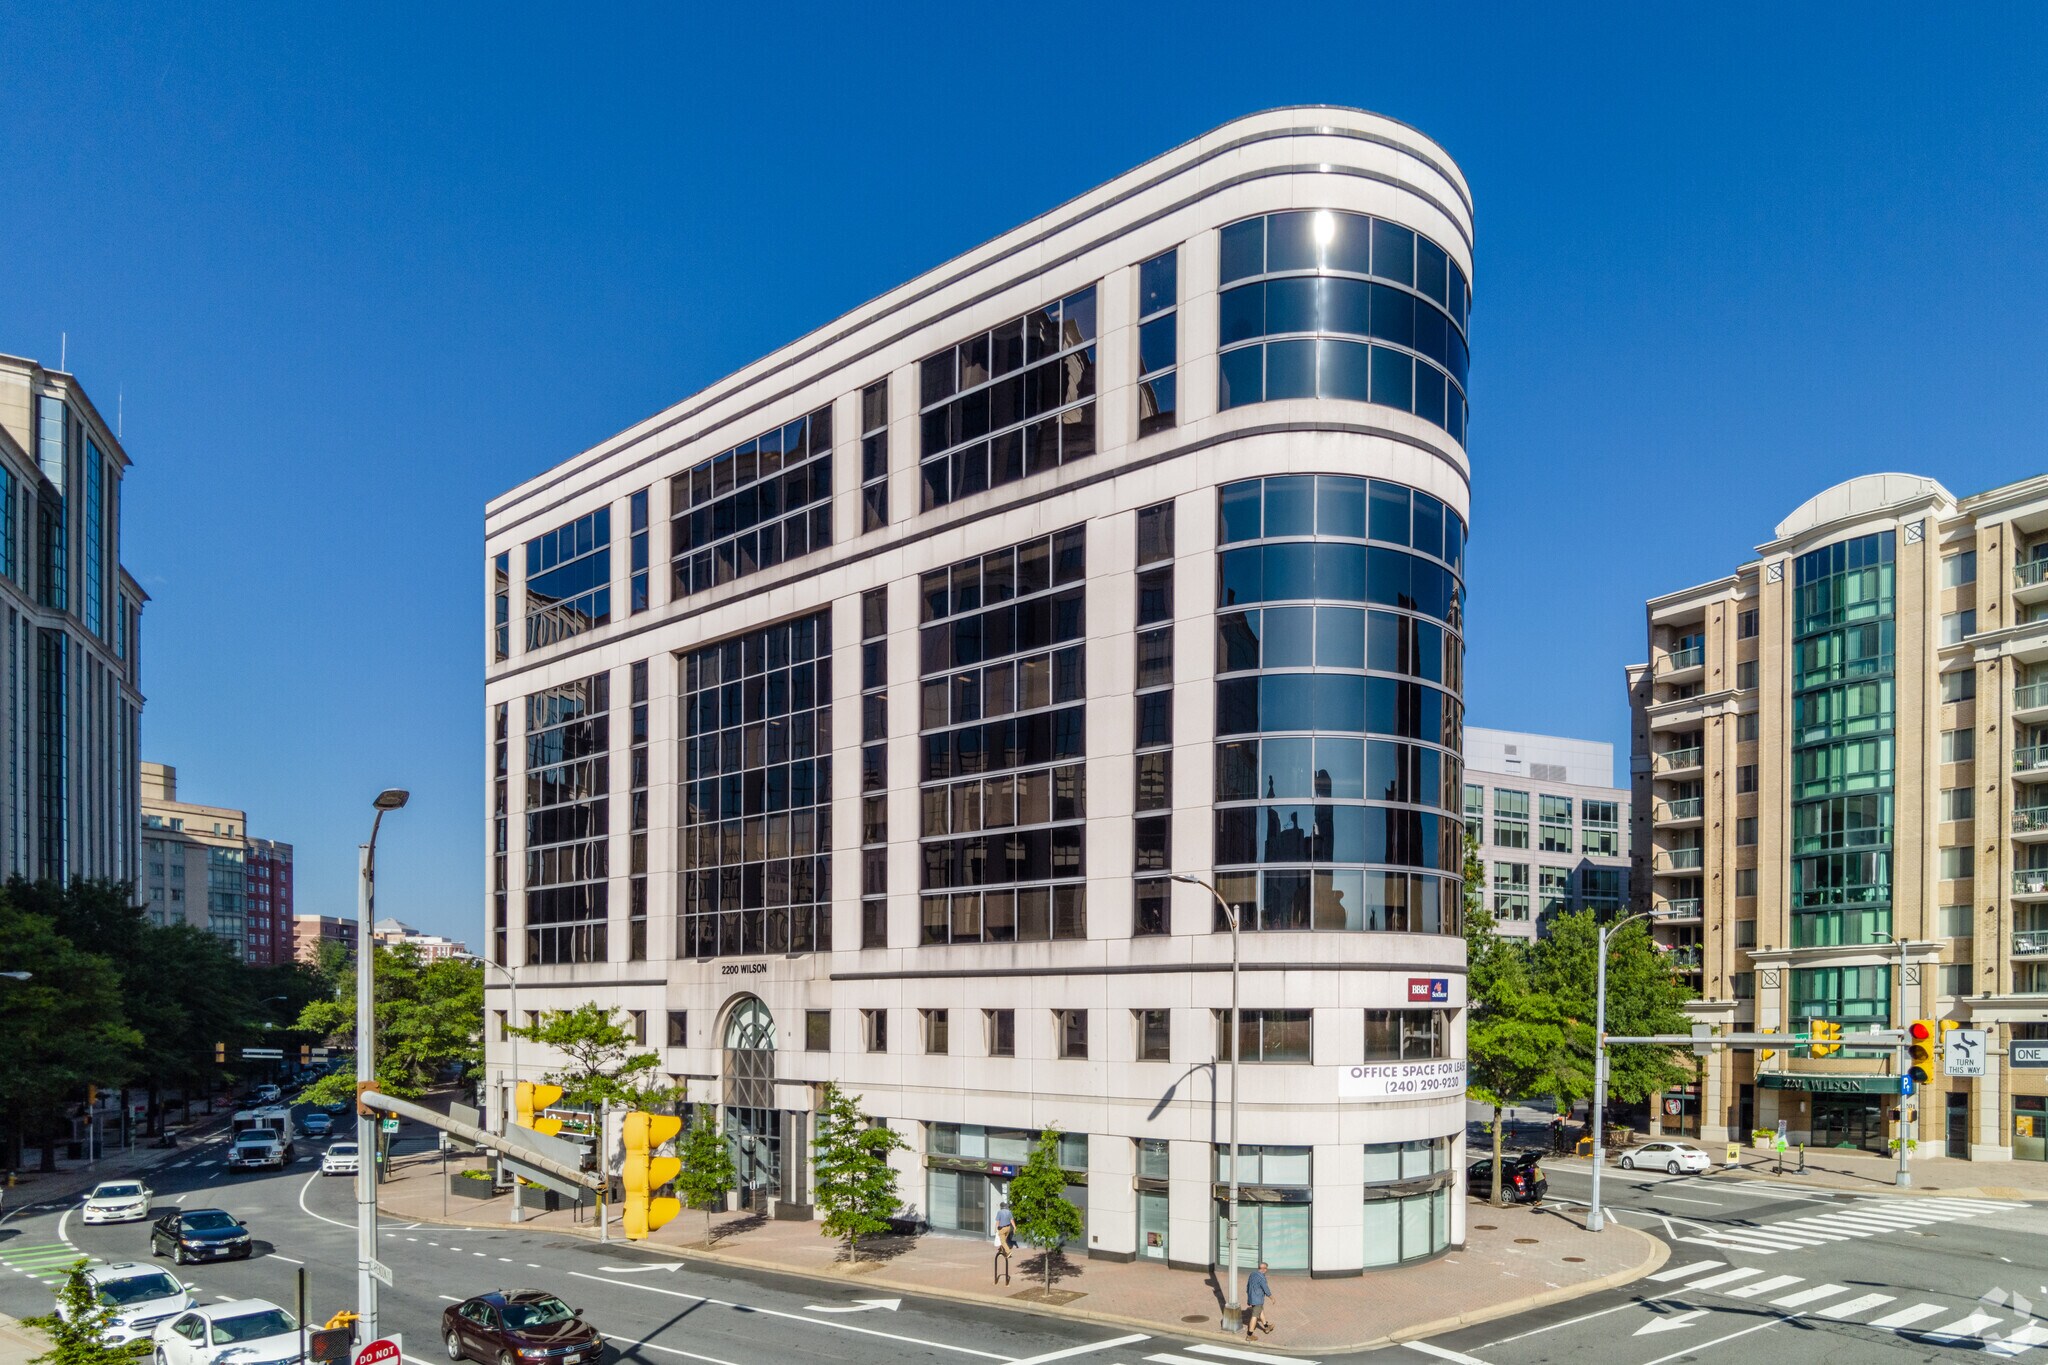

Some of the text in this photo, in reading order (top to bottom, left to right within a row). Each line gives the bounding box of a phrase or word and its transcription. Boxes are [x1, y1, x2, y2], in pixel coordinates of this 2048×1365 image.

[722, 963, 767, 974] 2200 WILSON
[1412, 985, 1429, 994] BB&T
[2017, 1049, 2041, 1060] ONE
[1350, 1066, 1398, 1079] OFFICE
[1402, 1064, 1435, 1077] SPACE
[1438, 1063, 1453, 1075] FOR
[1949, 1066, 1981, 1074] THIS WAY
[1385, 1076, 1459, 1094] (240) 290-9230
[1809, 1079, 1862, 1092] WILSON
[1903, 1077, 1909, 1089] P
[360, 1346, 395, 1365] DO NOT
